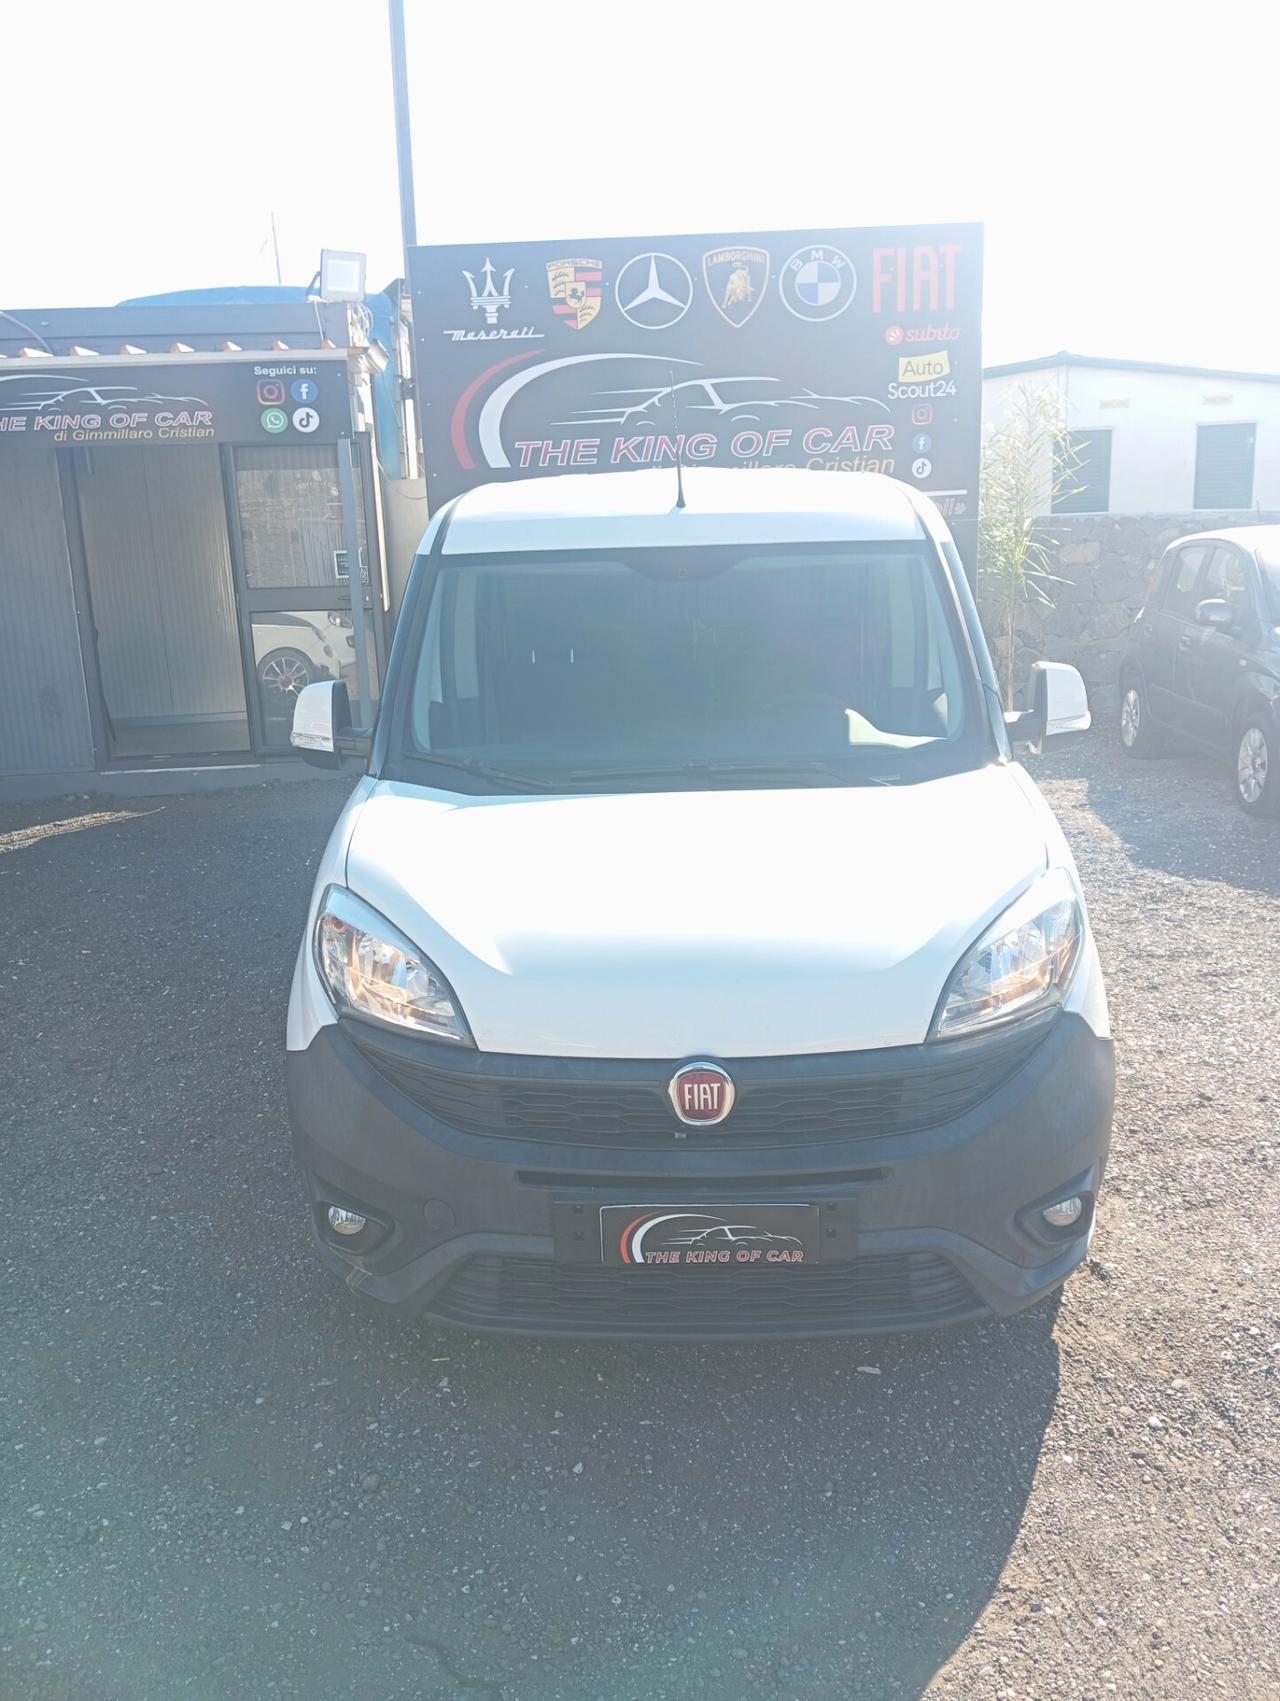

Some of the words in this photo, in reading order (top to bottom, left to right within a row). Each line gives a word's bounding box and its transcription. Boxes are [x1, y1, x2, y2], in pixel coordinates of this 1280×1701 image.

[872, 243, 962, 314] FIAT
[253, 365, 297, 377] Seguici
[299, 366, 317, 375] su:
[902, 360, 944, 377] Auto
[887, 379, 958, 400] Scout24
[33, 413, 102, 431] KING
[109, 412, 148, 428] OF
[154, 411, 213, 427] CAR
[54, 430, 67, 442] di
[72, 428, 153, 441] Gimmillaro
[158, 427, 215, 439] Cristian
[514, 438, 601, 468] THE
[610, 432, 719, 464] KING
[731, 429, 793, 458] OF
[802, 424, 895, 454] CAR
[684, 1082, 721, 1111] FIAT
[646, 1251, 680, 1264] THE
[685, 1250, 731, 1264] KING
[735, 1250, 762, 1263] OF
[766, 1250, 805, 1263] CAR
